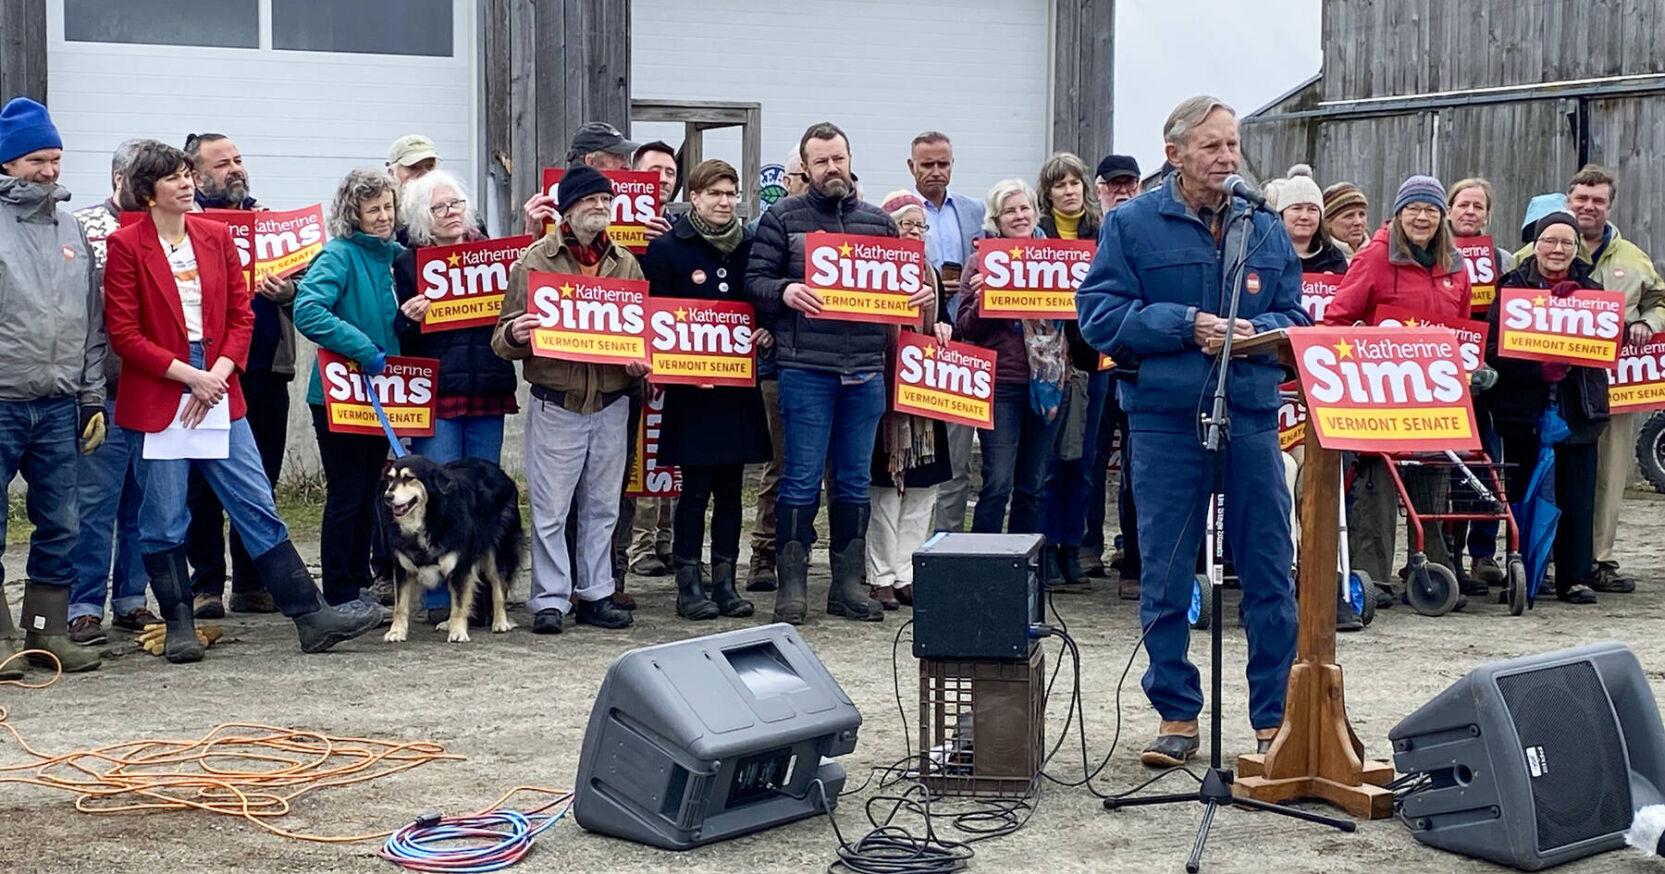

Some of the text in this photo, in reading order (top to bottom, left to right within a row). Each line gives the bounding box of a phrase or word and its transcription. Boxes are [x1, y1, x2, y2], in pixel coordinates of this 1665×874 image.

[855, 244, 919, 263] Katherine
[1025, 246, 1091, 261] Katherine
[423, 260, 520, 299] Sim
[811, 246, 920, 293] Sims
[984, 250, 1091, 289] Sims
[576, 284, 643, 303] Katherine
[991, 296, 1074, 307] VERMONT SENA
[1548, 295, 1619, 311] Katherine
[430, 303, 484, 318] VERMONT
[534, 286, 645, 334] Sims
[688, 307, 750, 324] Katherine
[1505, 298, 1620, 339] Sims
[651, 311, 752, 354] Sims
[542, 335, 638, 352] VERMONT SENATE
[1354, 338, 1453, 359] Katherine
[1511, 337, 1609, 356] VERMONT SENATE
[659, 360, 747, 373] VERMONT SENATE
[937, 346, 992, 371] Katherine
[325, 361, 432, 404] Sims
[900, 345, 991, 399] Sims
[1303, 345, 1463, 403] Sims
[904, 391, 984, 416] VERMONT SENATE
[1326, 415, 1461, 431] VERMONT SENATE
